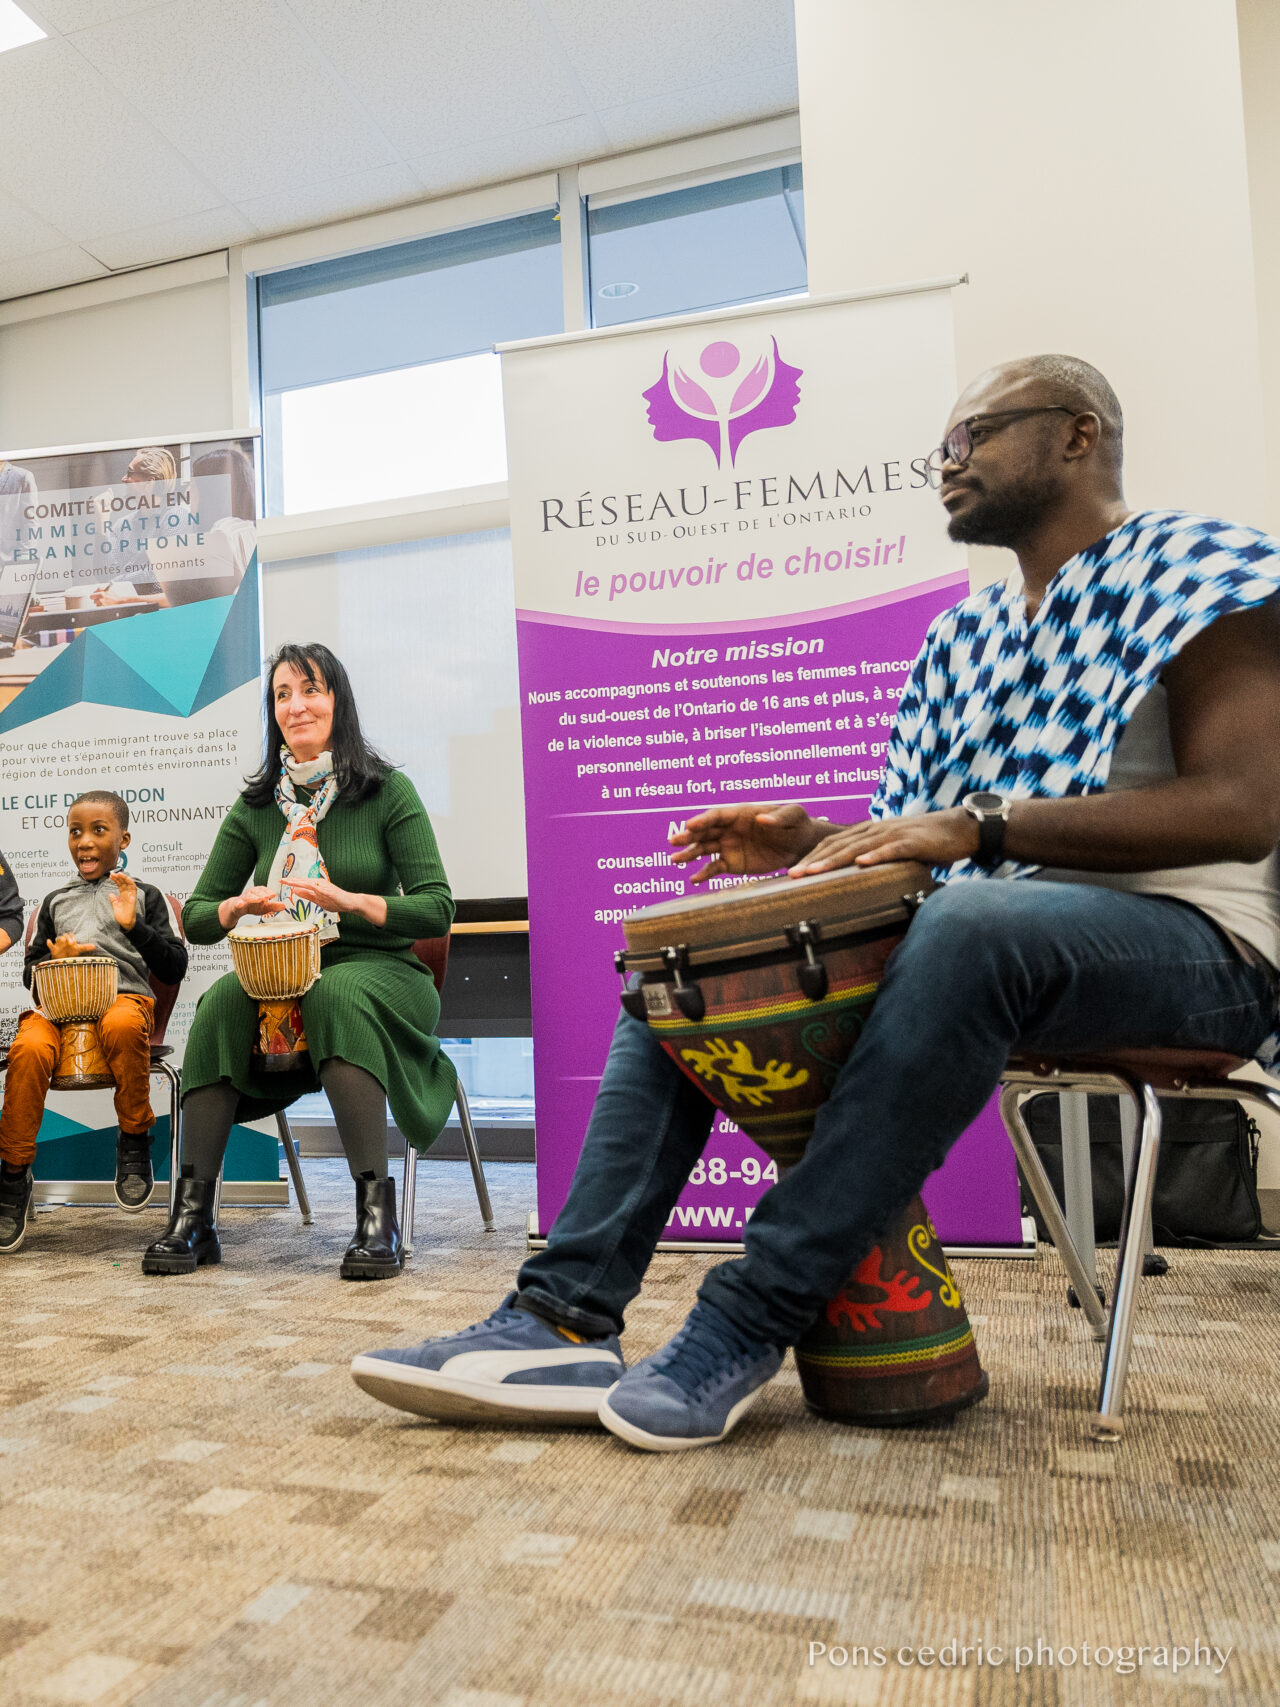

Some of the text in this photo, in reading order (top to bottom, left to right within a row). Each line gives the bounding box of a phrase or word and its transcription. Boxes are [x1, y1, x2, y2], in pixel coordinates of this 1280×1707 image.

[24, 491, 190, 520] COMITÉ LOCAL EN
[540, 458, 929, 532] RÉSEAU-FEMMES
[16, 512, 200, 541] IMMIGRATION
[596, 535, 618, 546] DU
[627, 522, 729, 544] SUD-OUEST
[739, 518, 759, 531] DE
[14, 532, 205, 562] FRANCOPHONE
[14, 557, 205, 583] London et comtés environnants
[575, 536, 906, 601] le pouvoir de choisir!
[652, 636, 824, 668] Notre mission
[528, 657, 917, 706] Nous accompagnons et soutenons les femmes franco
[559, 712, 576, 726] du
[580, 707, 649, 724] sud-ouest
[653, 704, 669, 720] de
[740, 698, 758, 713] de
[761, 695, 778, 710] 16
[783, 695, 809, 709] ans
[813, 693, 828, 707] et
[833, 689, 868, 707] plus,
[873, 687, 882, 701] à
[0, 728, 238, 752] Pour que chaque immigrant trouve sa place
[548, 737, 564, 752] de
[568, 736, 580, 751] la
[584, 731, 642, 749] violence
[645, 729, 688, 748] subie,
[692, 727, 701, 741] à
[705, 723, 747, 741] briser
[836, 713, 849, 730] et
[854, 713, 863, 727] à
[2, 757, 26, 768] pour
[30, 754, 57, 764] vivre
[60, 754, 70, 762] et
[150, 744, 192, 758] français
[197, 743, 224, 754] dans
[228, 742, 236, 752] la
[577, 754, 694, 779] personnellement
[698, 752, 712, 767] et
[716, 741, 867, 767] professionnellement
[2, 769, 36, 782] région
[40, 768, 54, 777] de
[57, 766, 96, 776] London
[100, 764, 111, 774] et
[115, 762, 154, 772] comtés
[158, 758, 231, 770] environnants
[601, 766, 886, 800] à un réseau fort, rassembleur et inclusi
[2, 796, 19, 810] LE
[24, 794, 58, 808] CLIF
[63, 793, 86, 807] D
[22, 816, 38, 829] ET
[43, 815, 68, 828] CO
[142, 841, 183, 853] Consult
[142, 855, 166, 863] about
[14, 871, 39, 879] ration
[59, 859, 69, 867] de
[142, 865, 191, 874] immigration
[614, 878, 684, 895] coaching
